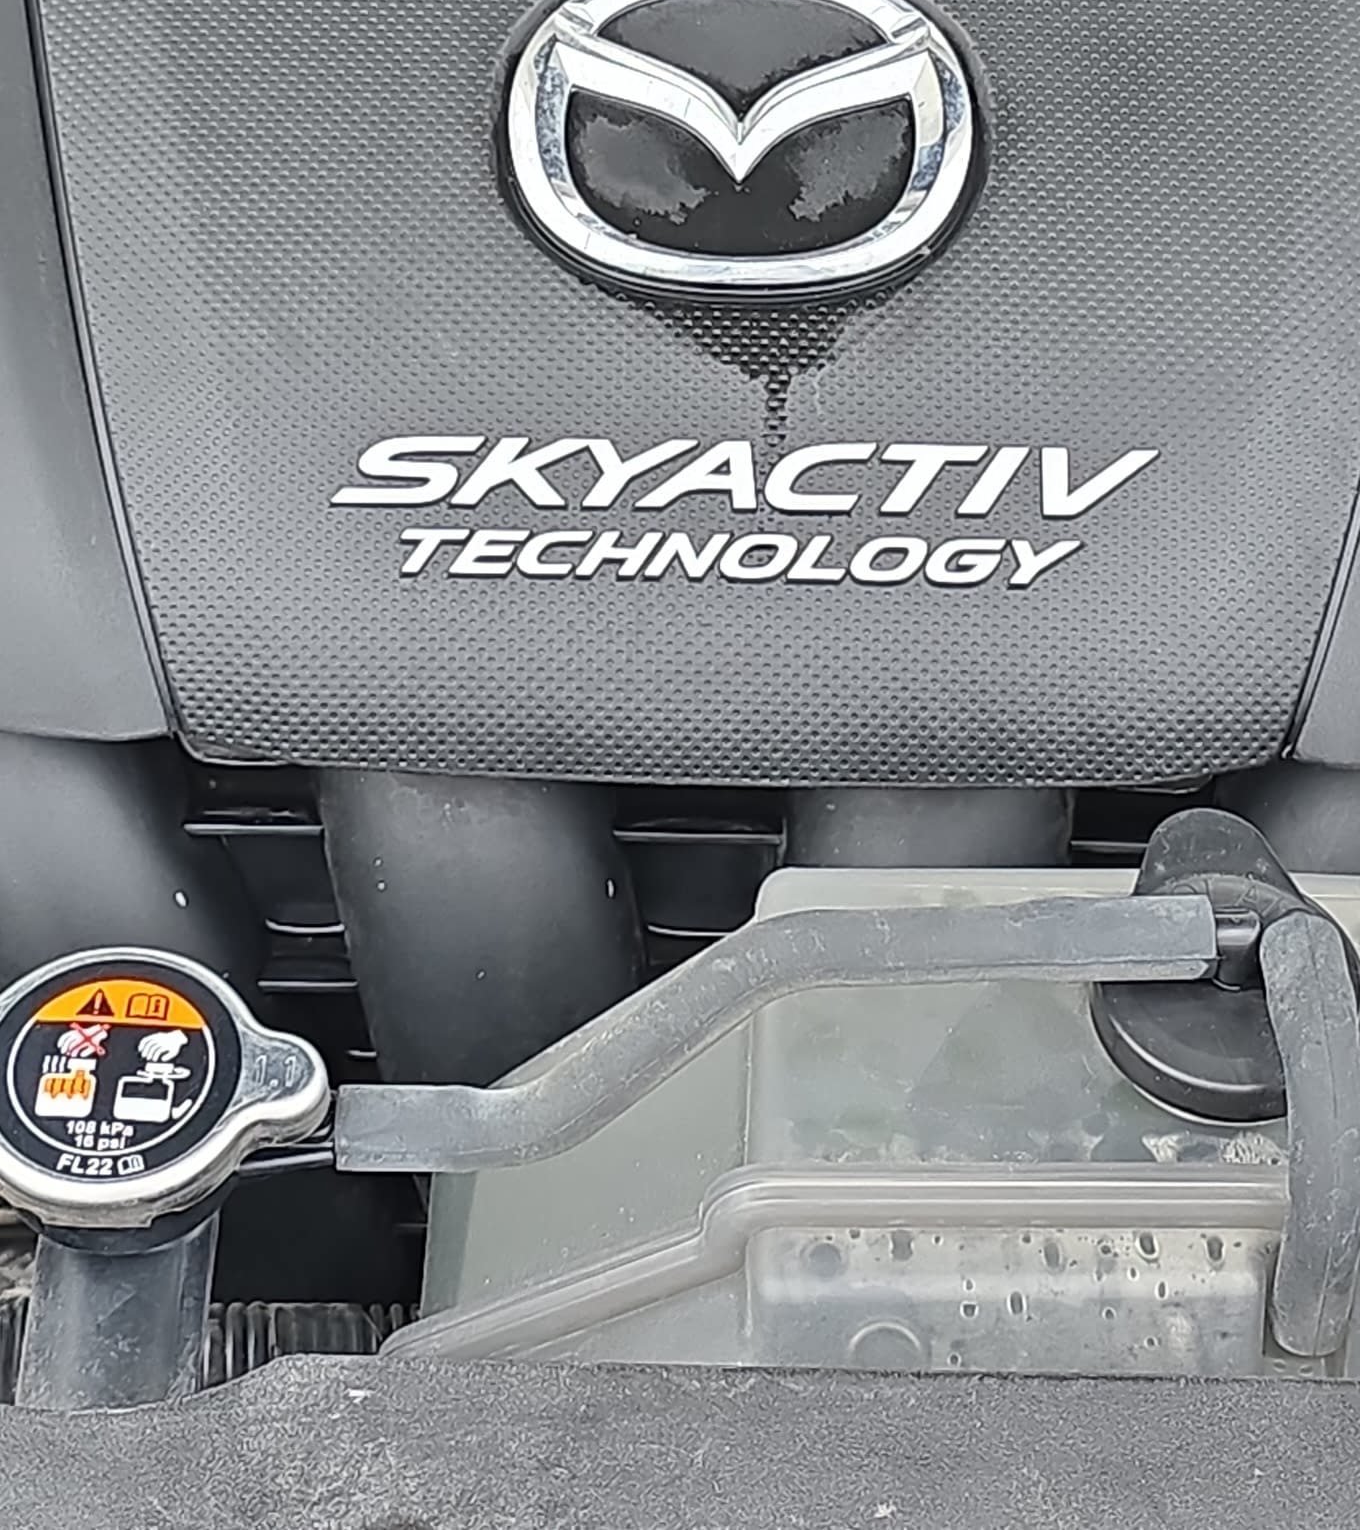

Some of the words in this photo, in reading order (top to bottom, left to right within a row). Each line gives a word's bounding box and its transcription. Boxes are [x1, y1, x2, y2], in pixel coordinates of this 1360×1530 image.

[328, 434, 1160, 518] SKYACTIV
[397, 526, 1083, 589] TECHNOLOGY
[65, 1120, 97, 1135] 108
[100, 1121, 135, 1137] kPa
[74, 1134, 95, 1148] 16
[97, 1135, 127, 1151] psi
[56, 1152, 114, 1176] FL22
